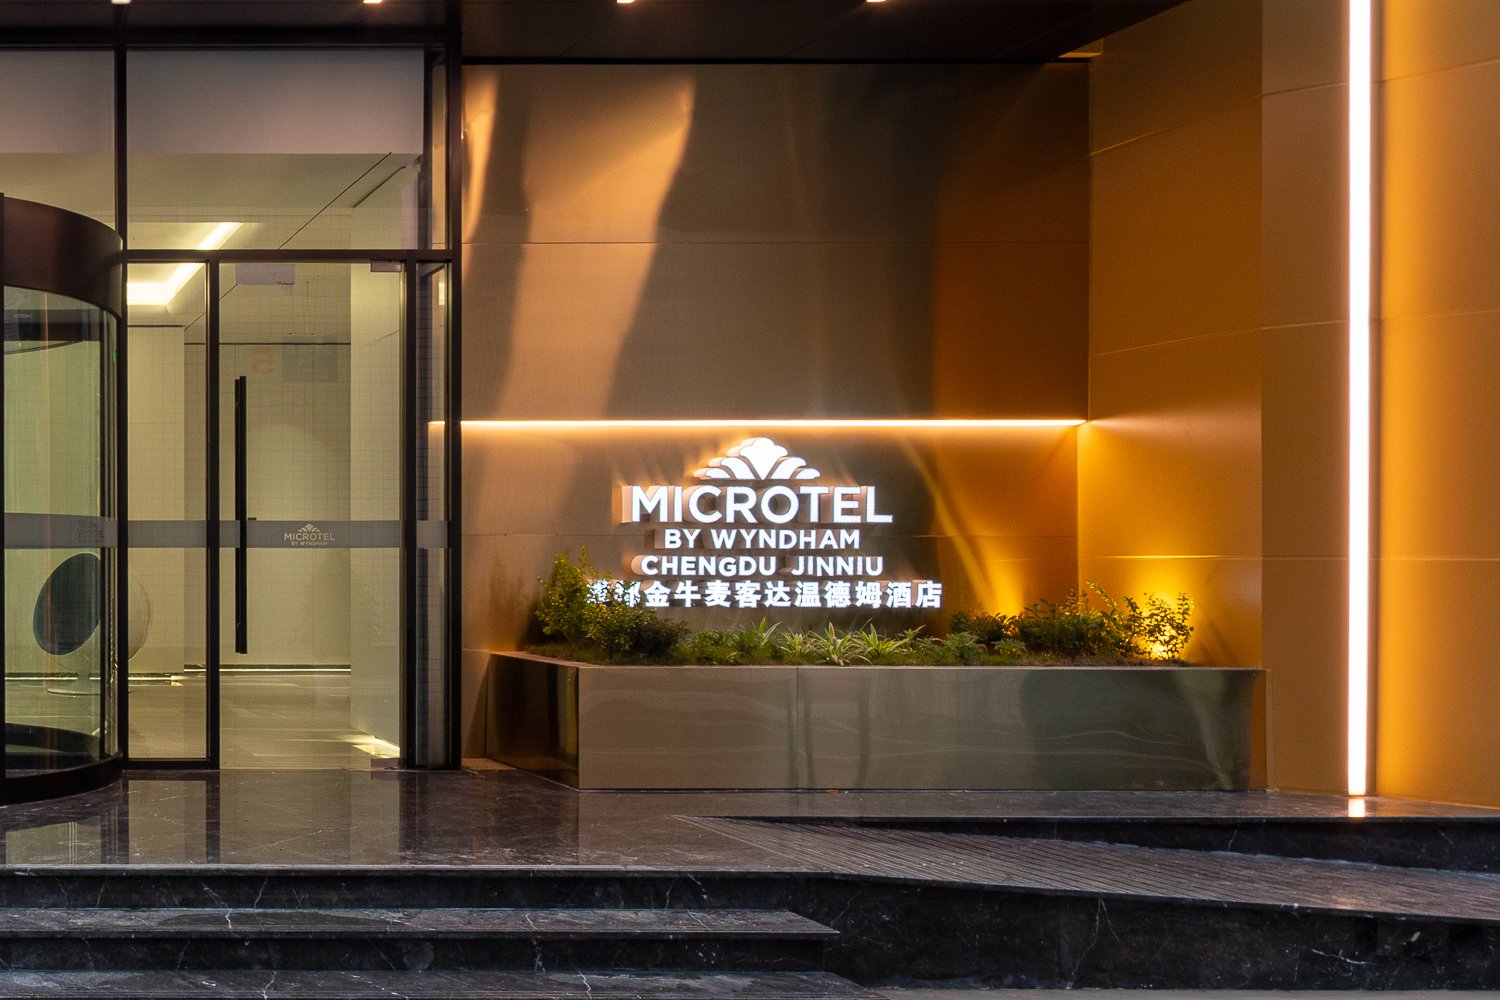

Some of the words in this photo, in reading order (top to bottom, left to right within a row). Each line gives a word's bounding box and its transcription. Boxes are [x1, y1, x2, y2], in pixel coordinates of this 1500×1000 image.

[631, 484, 893, 524] MICROTEL
[284, 532, 336, 541] MICROTEL
[664, 528, 701, 549] BY
[710, 528, 861, 550] WYNDHAM
[640, 555, 777, 577] CHENGDU
[790, 555, 884, 577] JINNIU
